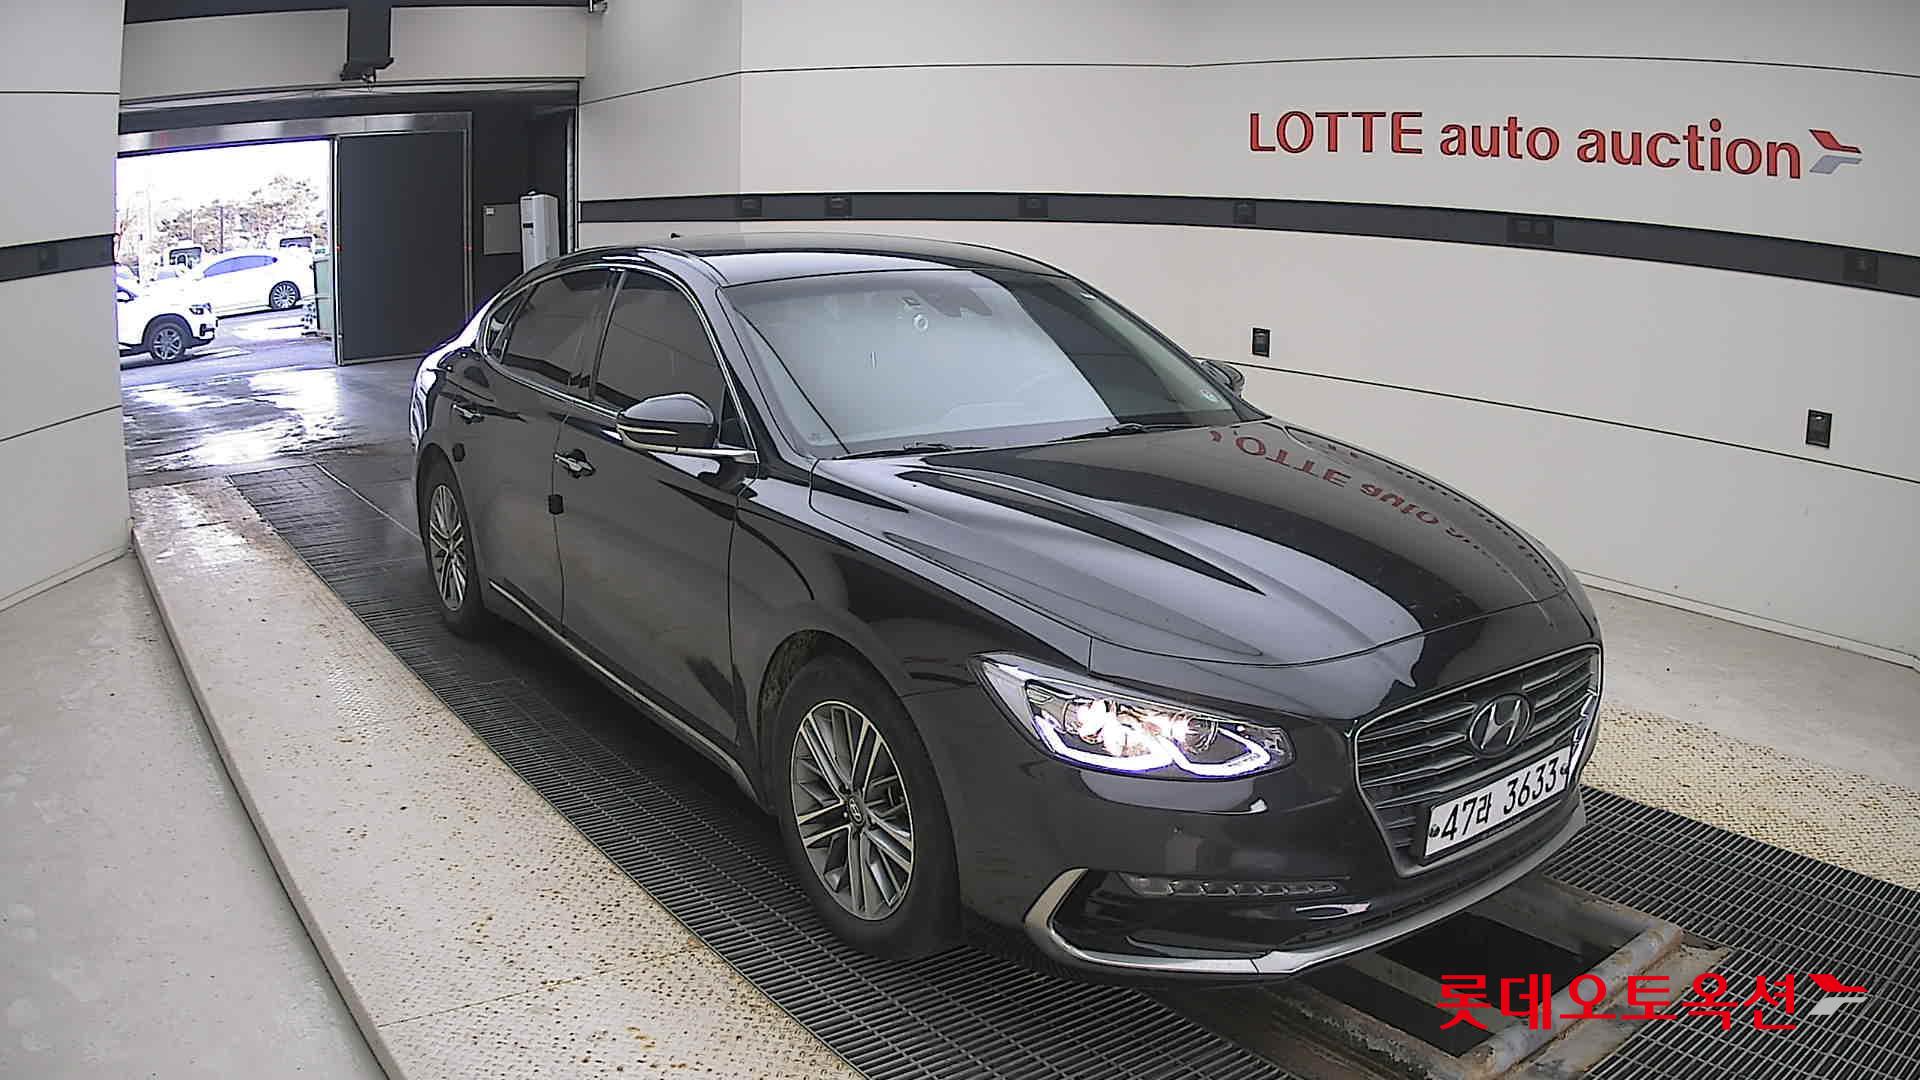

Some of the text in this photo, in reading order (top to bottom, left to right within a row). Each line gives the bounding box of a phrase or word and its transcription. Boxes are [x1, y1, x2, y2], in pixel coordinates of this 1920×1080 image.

[1249, 111, 1801, 179] LOTTE auto auction
[1440, 757, 1559, 840] 47라 3633
